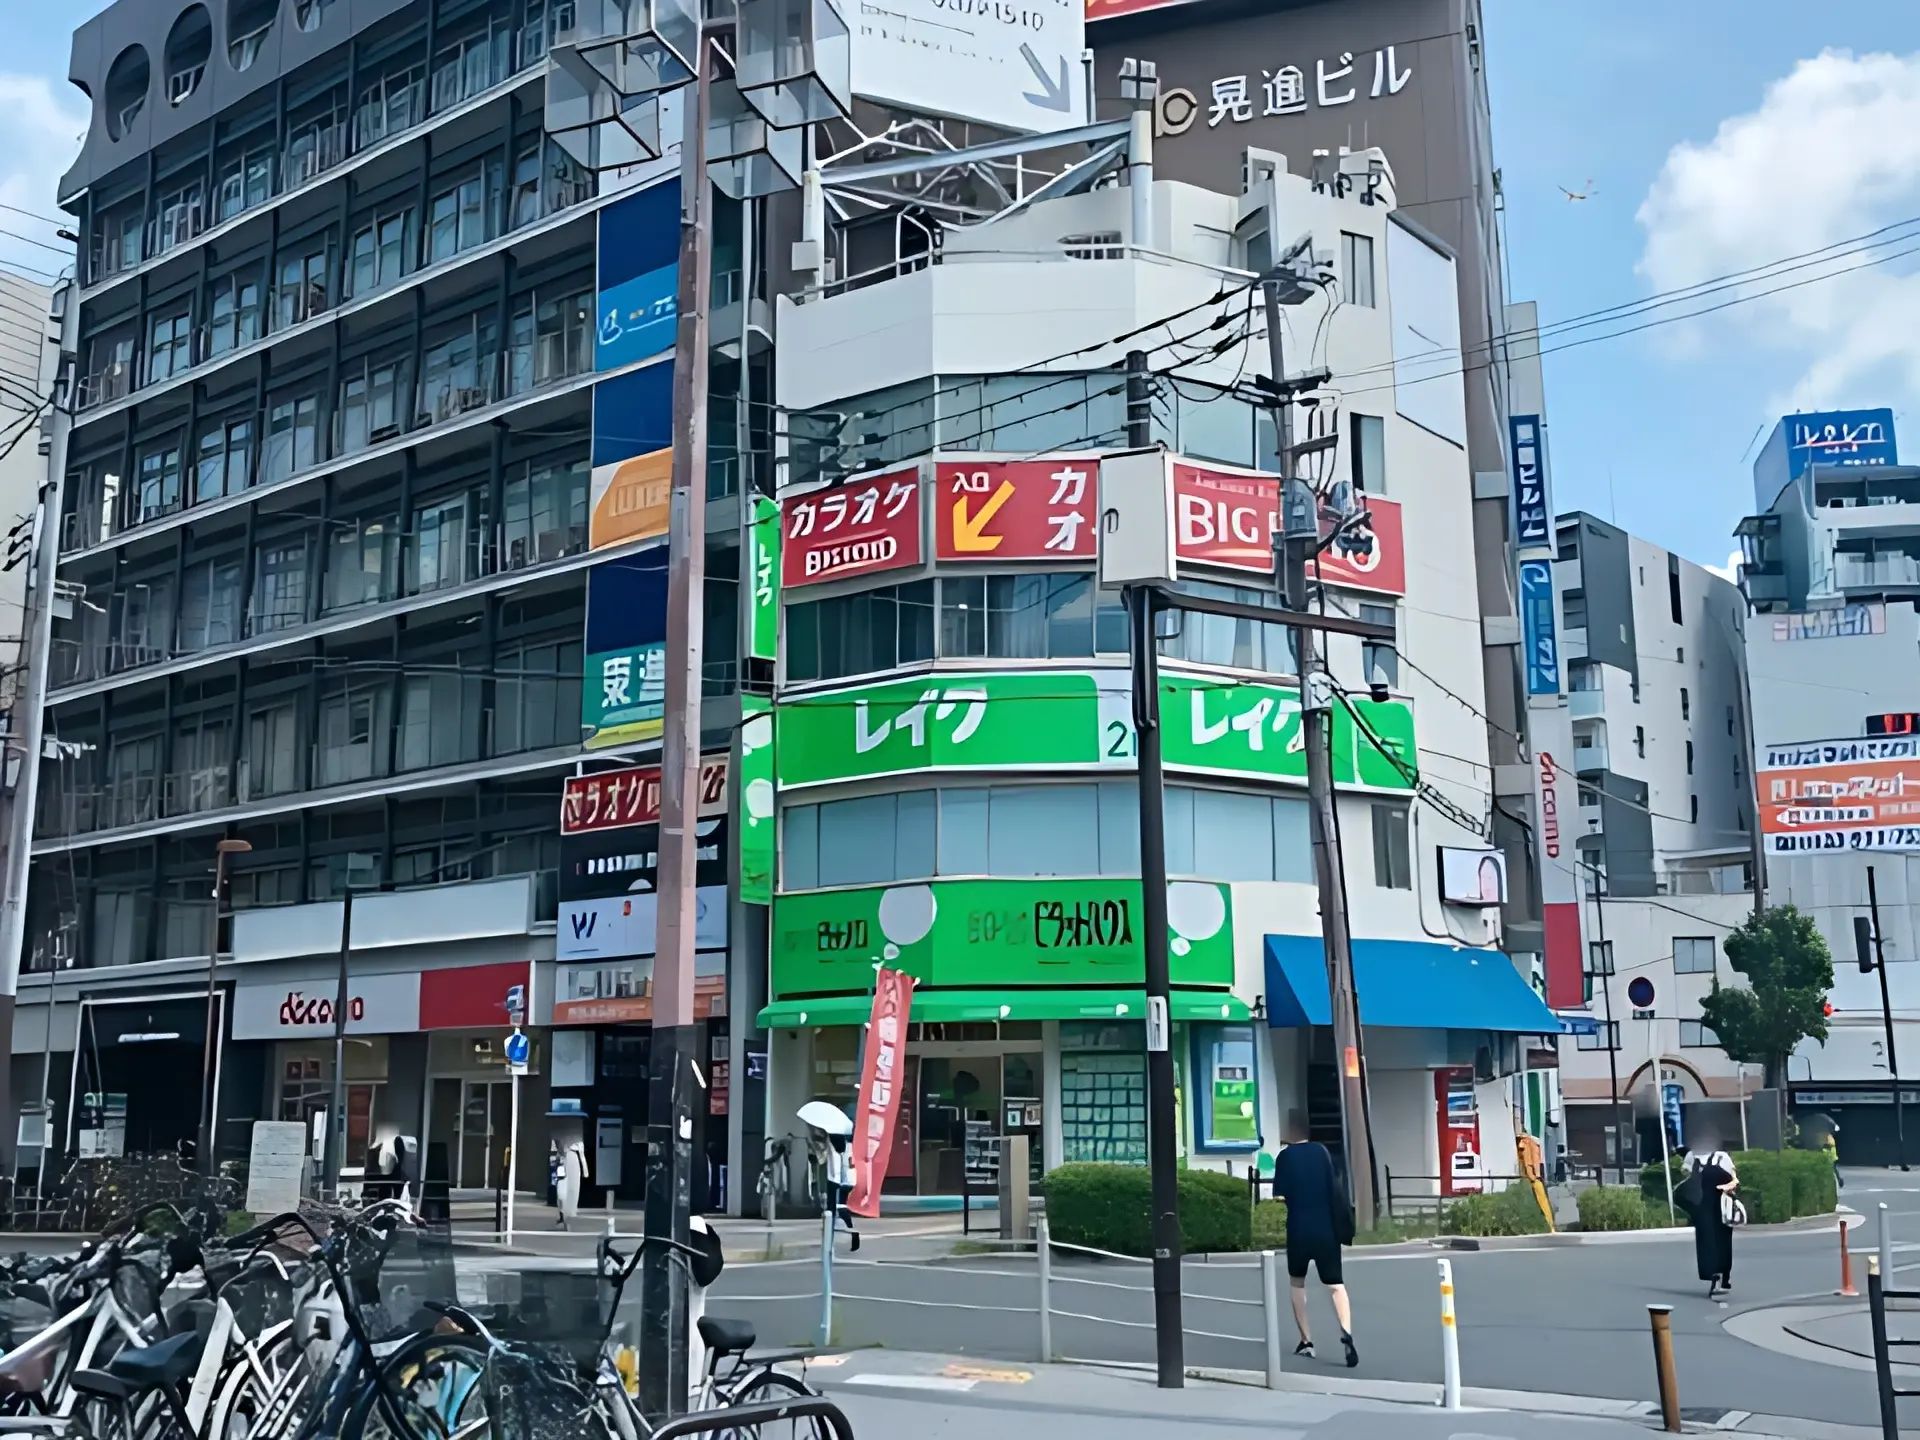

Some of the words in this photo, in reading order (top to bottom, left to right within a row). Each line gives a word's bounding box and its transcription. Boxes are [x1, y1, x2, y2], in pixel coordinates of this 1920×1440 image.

[951, 471, 991, 493] 入口
[788, 482, 917, 539] カラオケ
[1177, 493, 1259, 545] BIG
[855, 686, 988, 754] レイク
